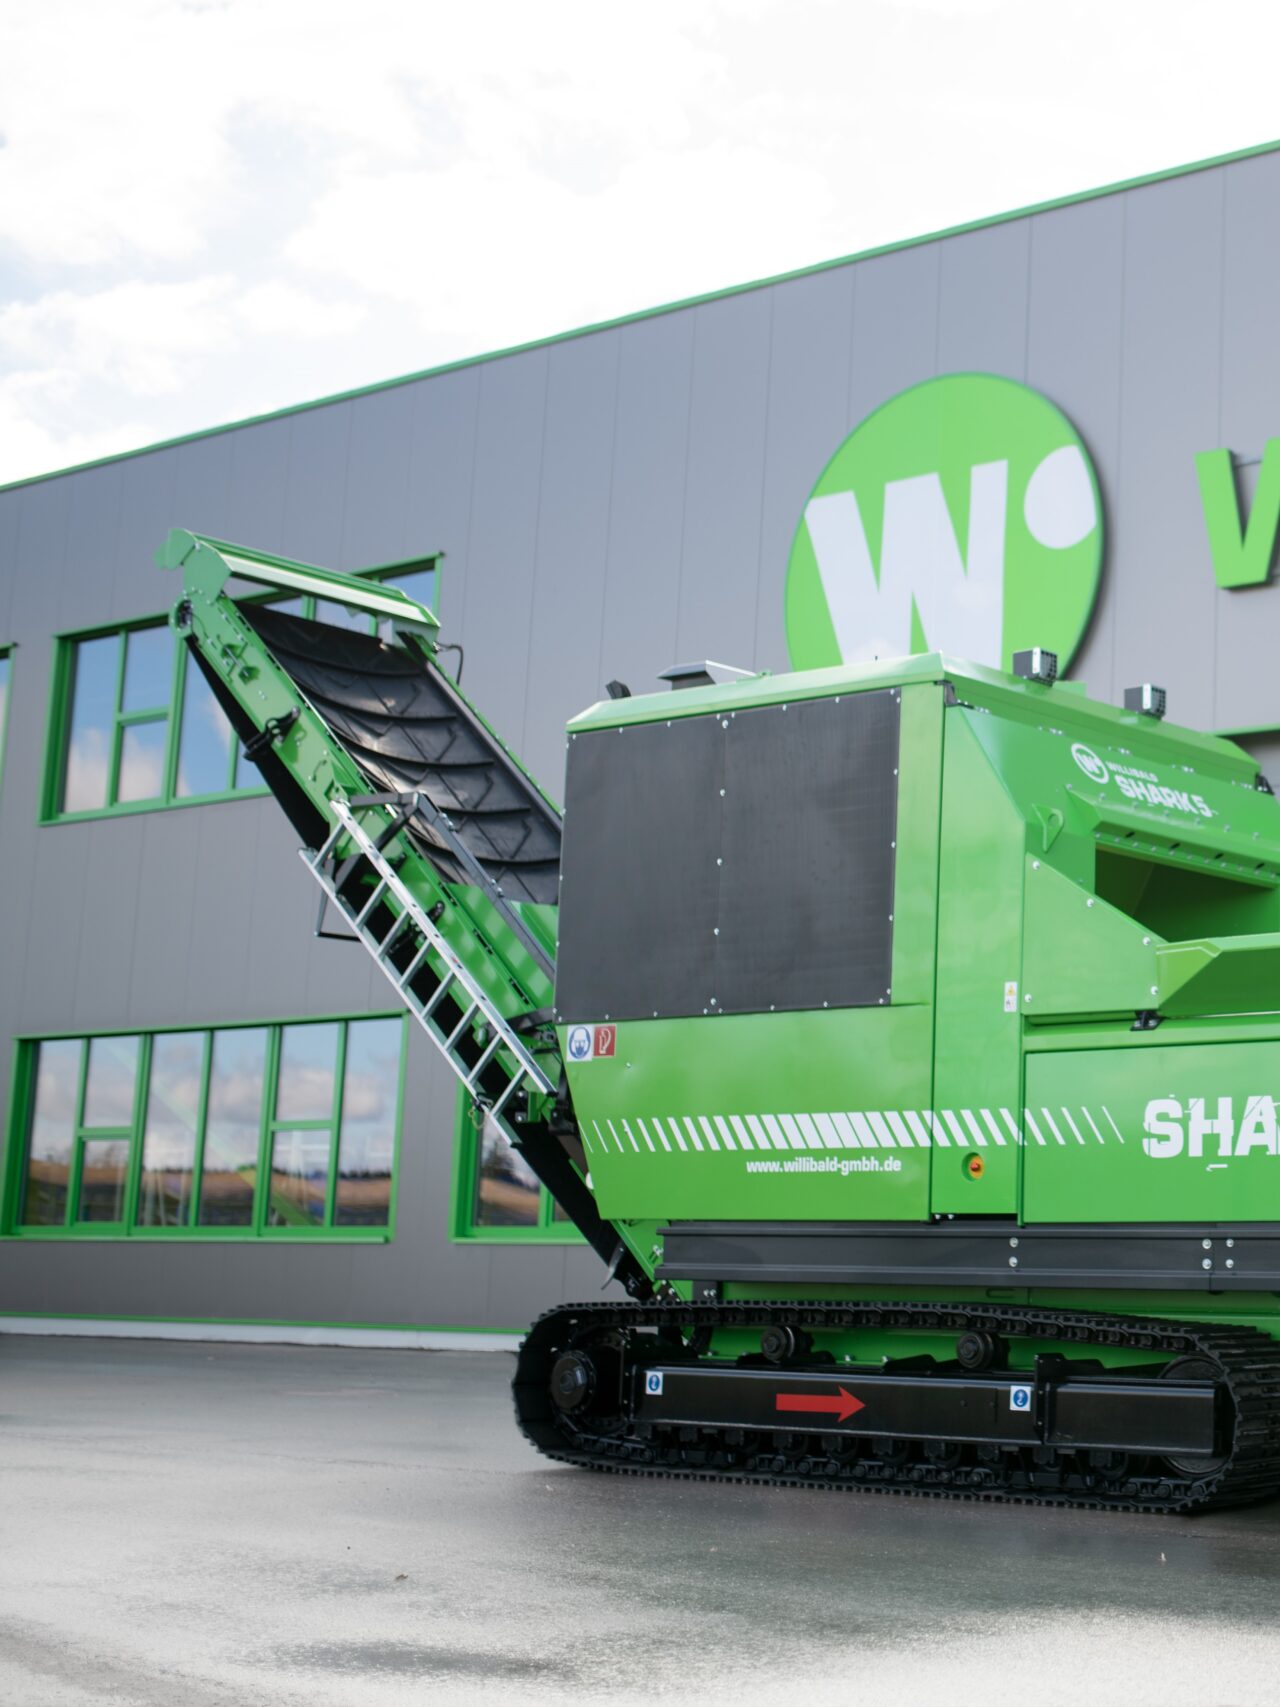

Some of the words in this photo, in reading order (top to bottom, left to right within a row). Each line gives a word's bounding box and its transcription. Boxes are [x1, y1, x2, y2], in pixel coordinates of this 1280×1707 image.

[1105, 760, 1159, 782] WILLIBALD
[1114, 774, 1199, 815] SHARK
[1190, 793, 1213, 818] 5
[746, 1156, 902, 1176] www.willibald-gmbh.de
